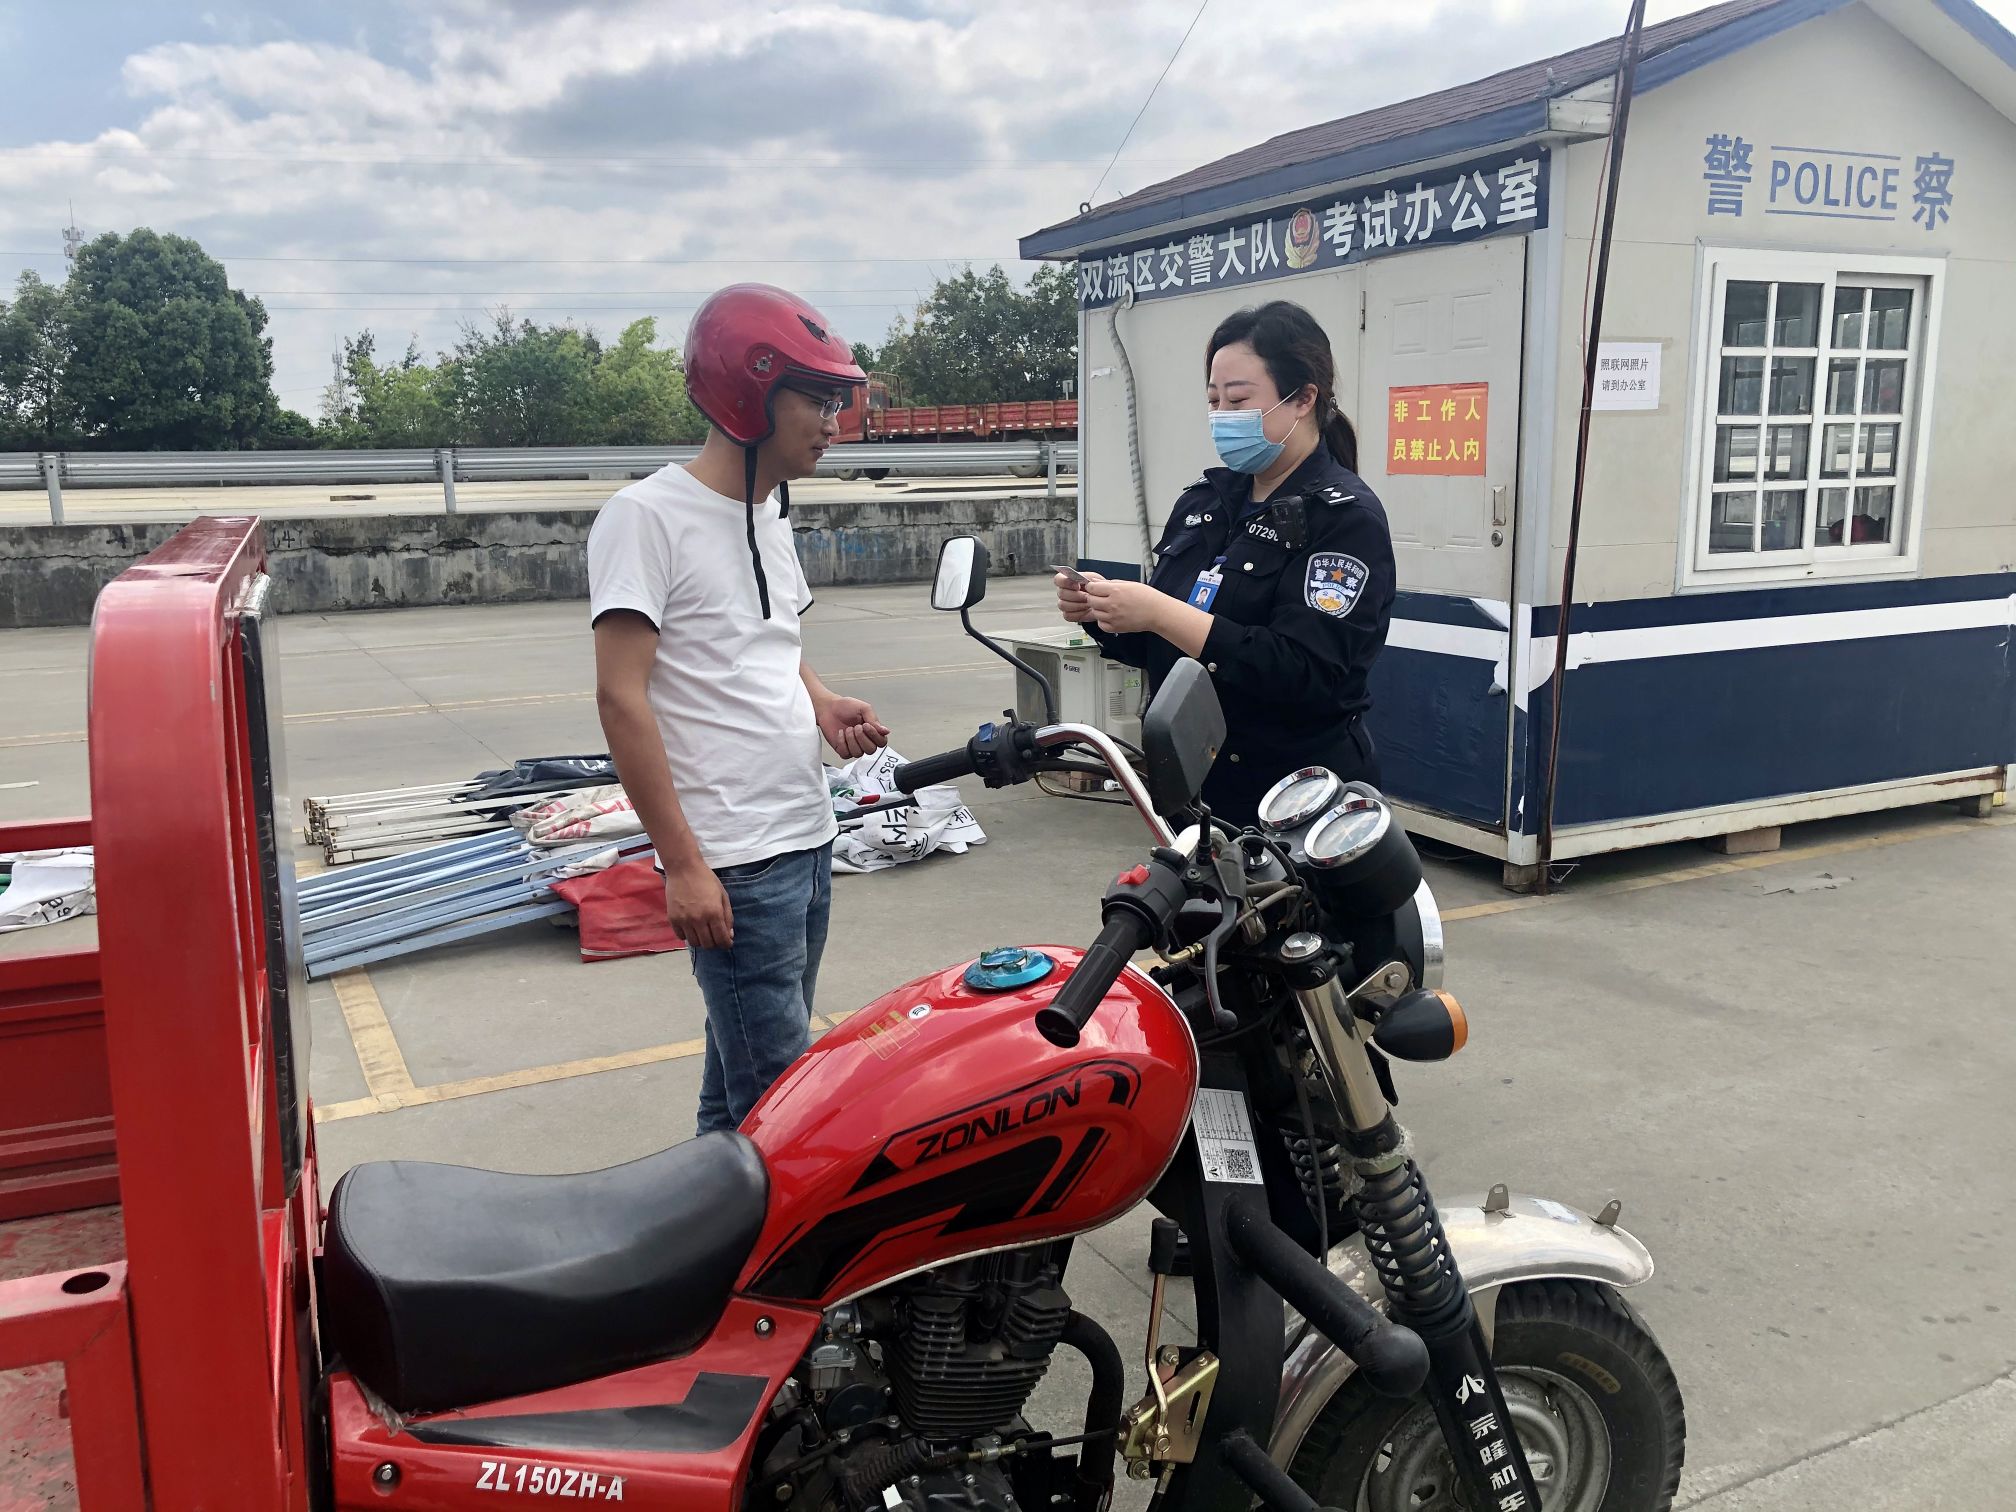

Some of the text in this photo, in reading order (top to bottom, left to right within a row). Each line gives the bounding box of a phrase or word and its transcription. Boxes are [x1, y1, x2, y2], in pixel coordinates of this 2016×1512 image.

[1703, 134, 1956, 231] 警 POLICE 察
[1080, 158, 1540, 302] 双流区交警大队 考试办公室
[1602, 379, 1647, 391] 请到办公室
[1394, 397, 1481, 422] 非工作人
[1393, 438, 1480, 461] 员禁止入内
[1313, 558, 1365, 580] 中华人民共和国
[915, 1078, 1081, 1165] ZONLON
[476, 1461, 623, 1501] ZL150ZH-A
[1469, 1412, 1526, 1512] 宗隆机车
